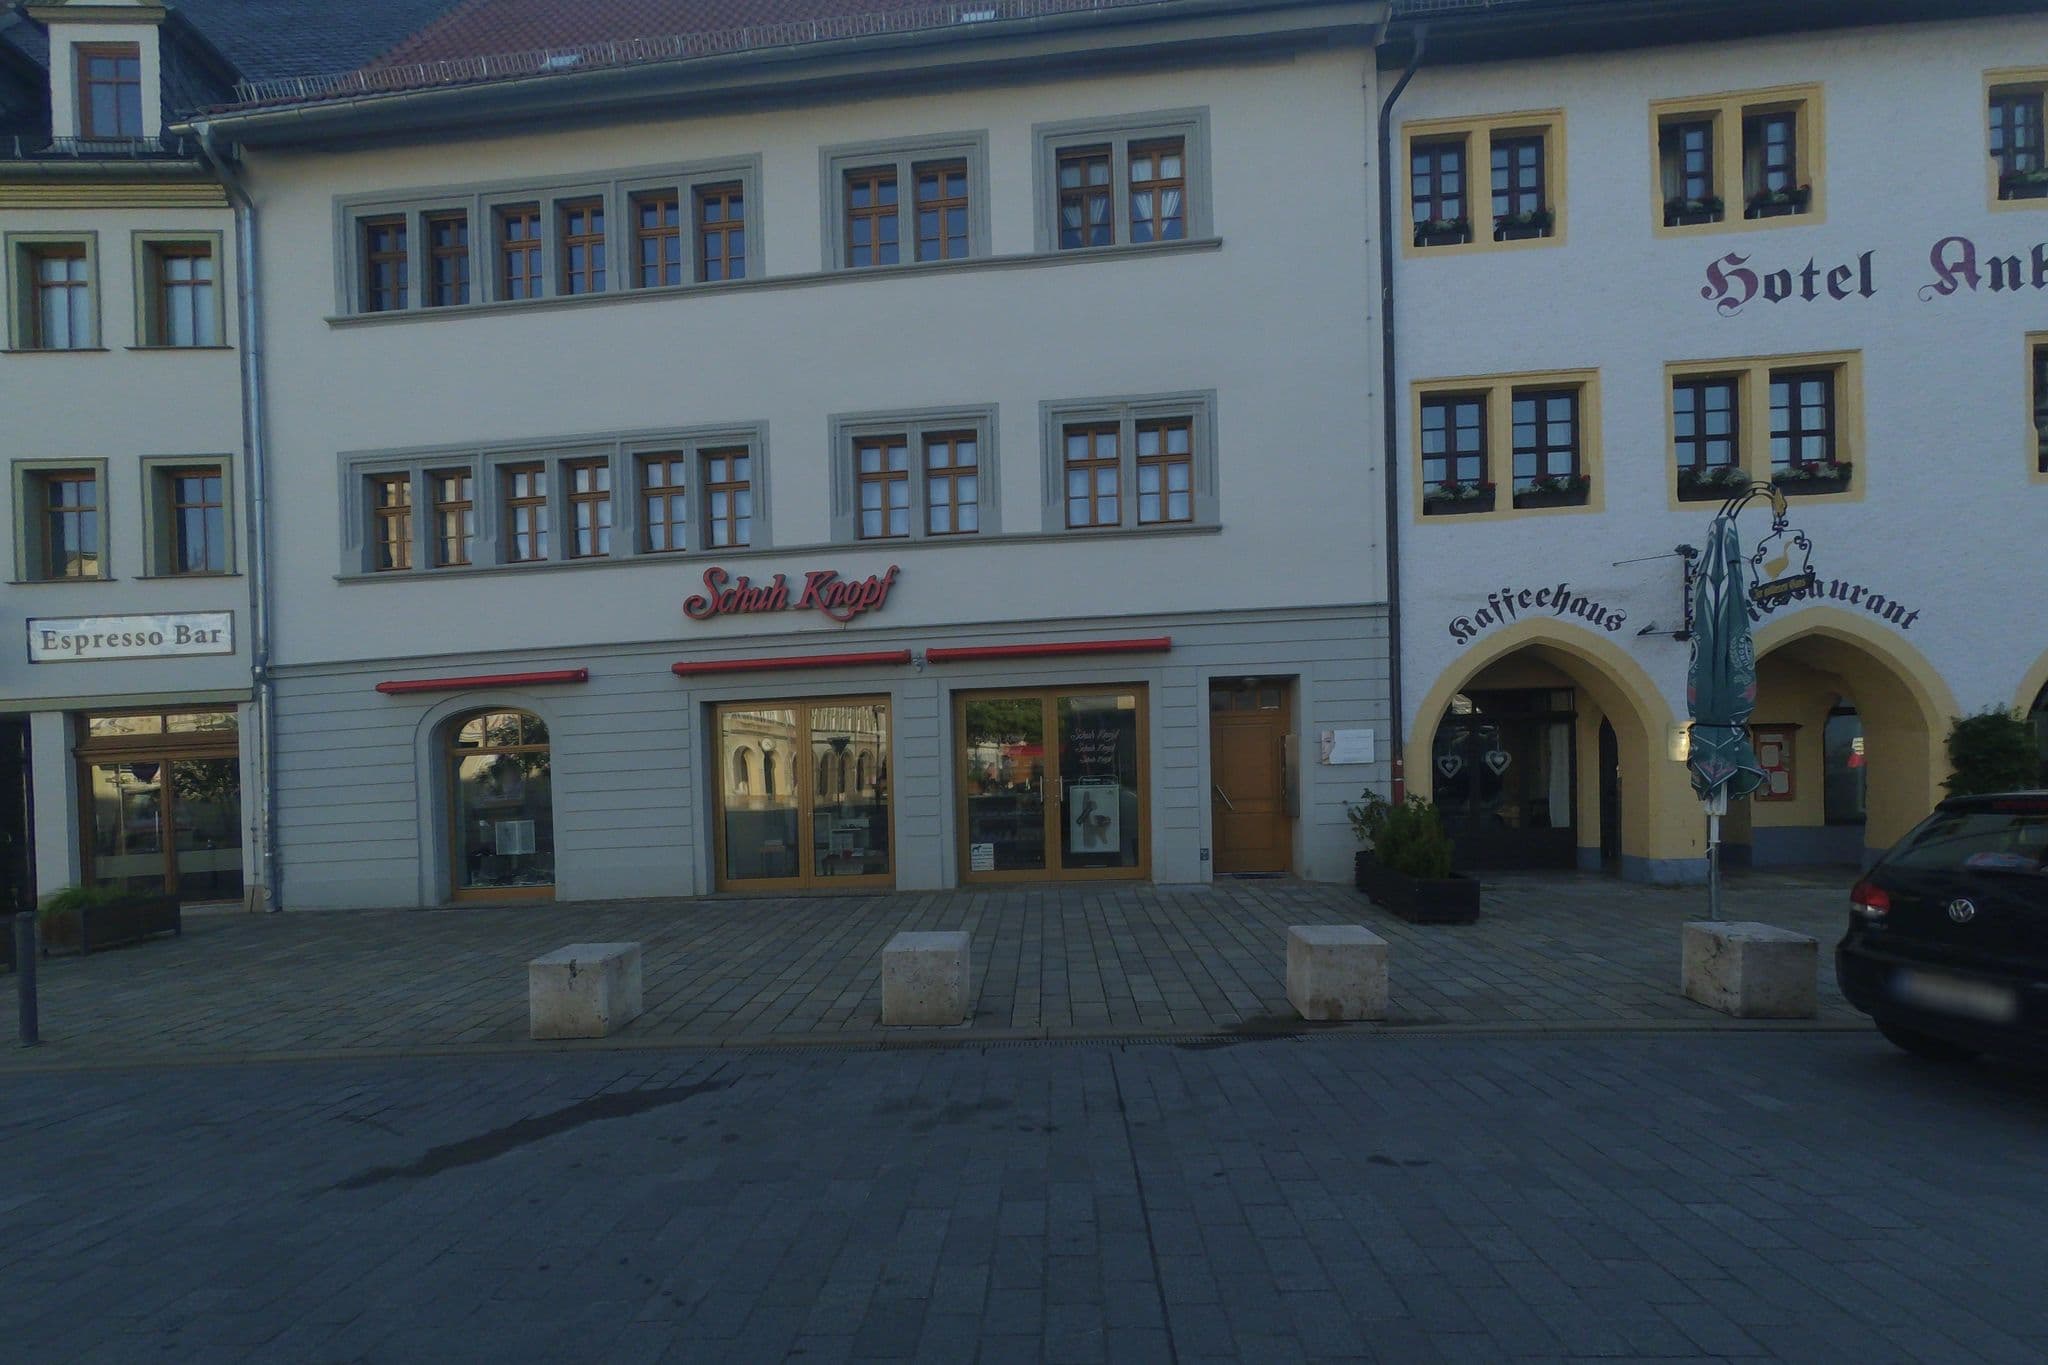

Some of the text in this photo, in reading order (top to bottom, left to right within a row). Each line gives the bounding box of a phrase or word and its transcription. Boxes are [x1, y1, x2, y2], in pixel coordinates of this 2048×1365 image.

[1701, 248, 1880, 318] Hotel
[683, 563, 901, 622] Schuh Knopf
[1448, 582, 1628, 646] Kaffeehaus
[41, 624, 222, 656] Espresso Bar
